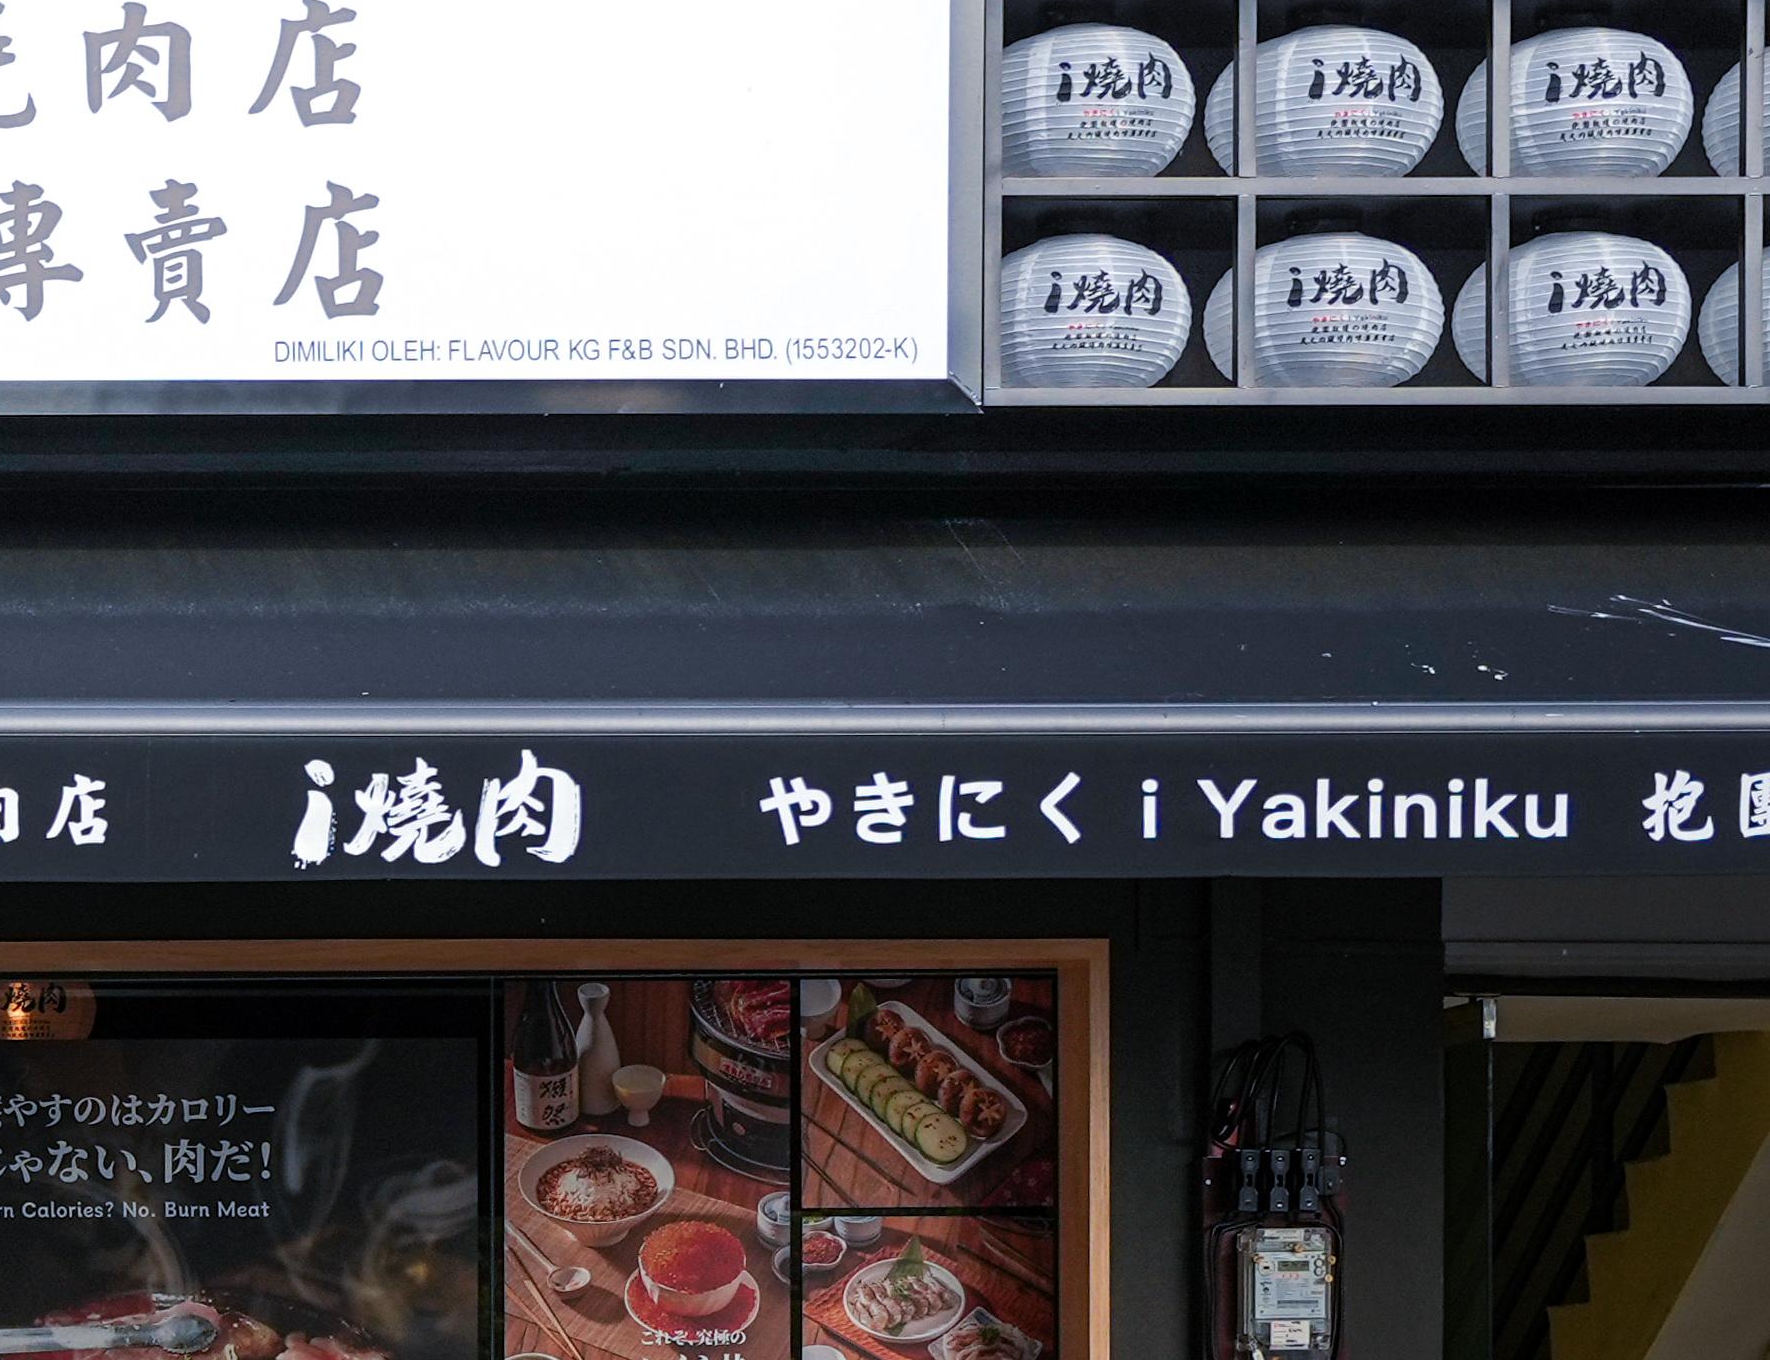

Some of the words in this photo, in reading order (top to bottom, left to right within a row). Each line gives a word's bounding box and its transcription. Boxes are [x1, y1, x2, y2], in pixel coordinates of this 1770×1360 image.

[275, 341, 363, 362] DIMILIKI
[372, 340, 440, 361] OLEH:
[449, 339, 559, 361] FLAVOUR
[570, 339, 599, 360] KG
[609, 339, 652, 360] F&B
[663, 339, 716, 360] SDN.
[726, 339, 777, 359] BHD.
[786, 337, 917, 364] (1553202-K)
[760, 772, 1080, 845] やきにく
[1142, 779, 1158, 838] i
[1197, 779, 1567, 838] Yakiniku
[22, 1201, 114, 1220] Calories?
[122, 1202, 156, 1219] No.
[165, 1202, 210, 1219] Burn
[218, 1202, 270, 1219] Meat
